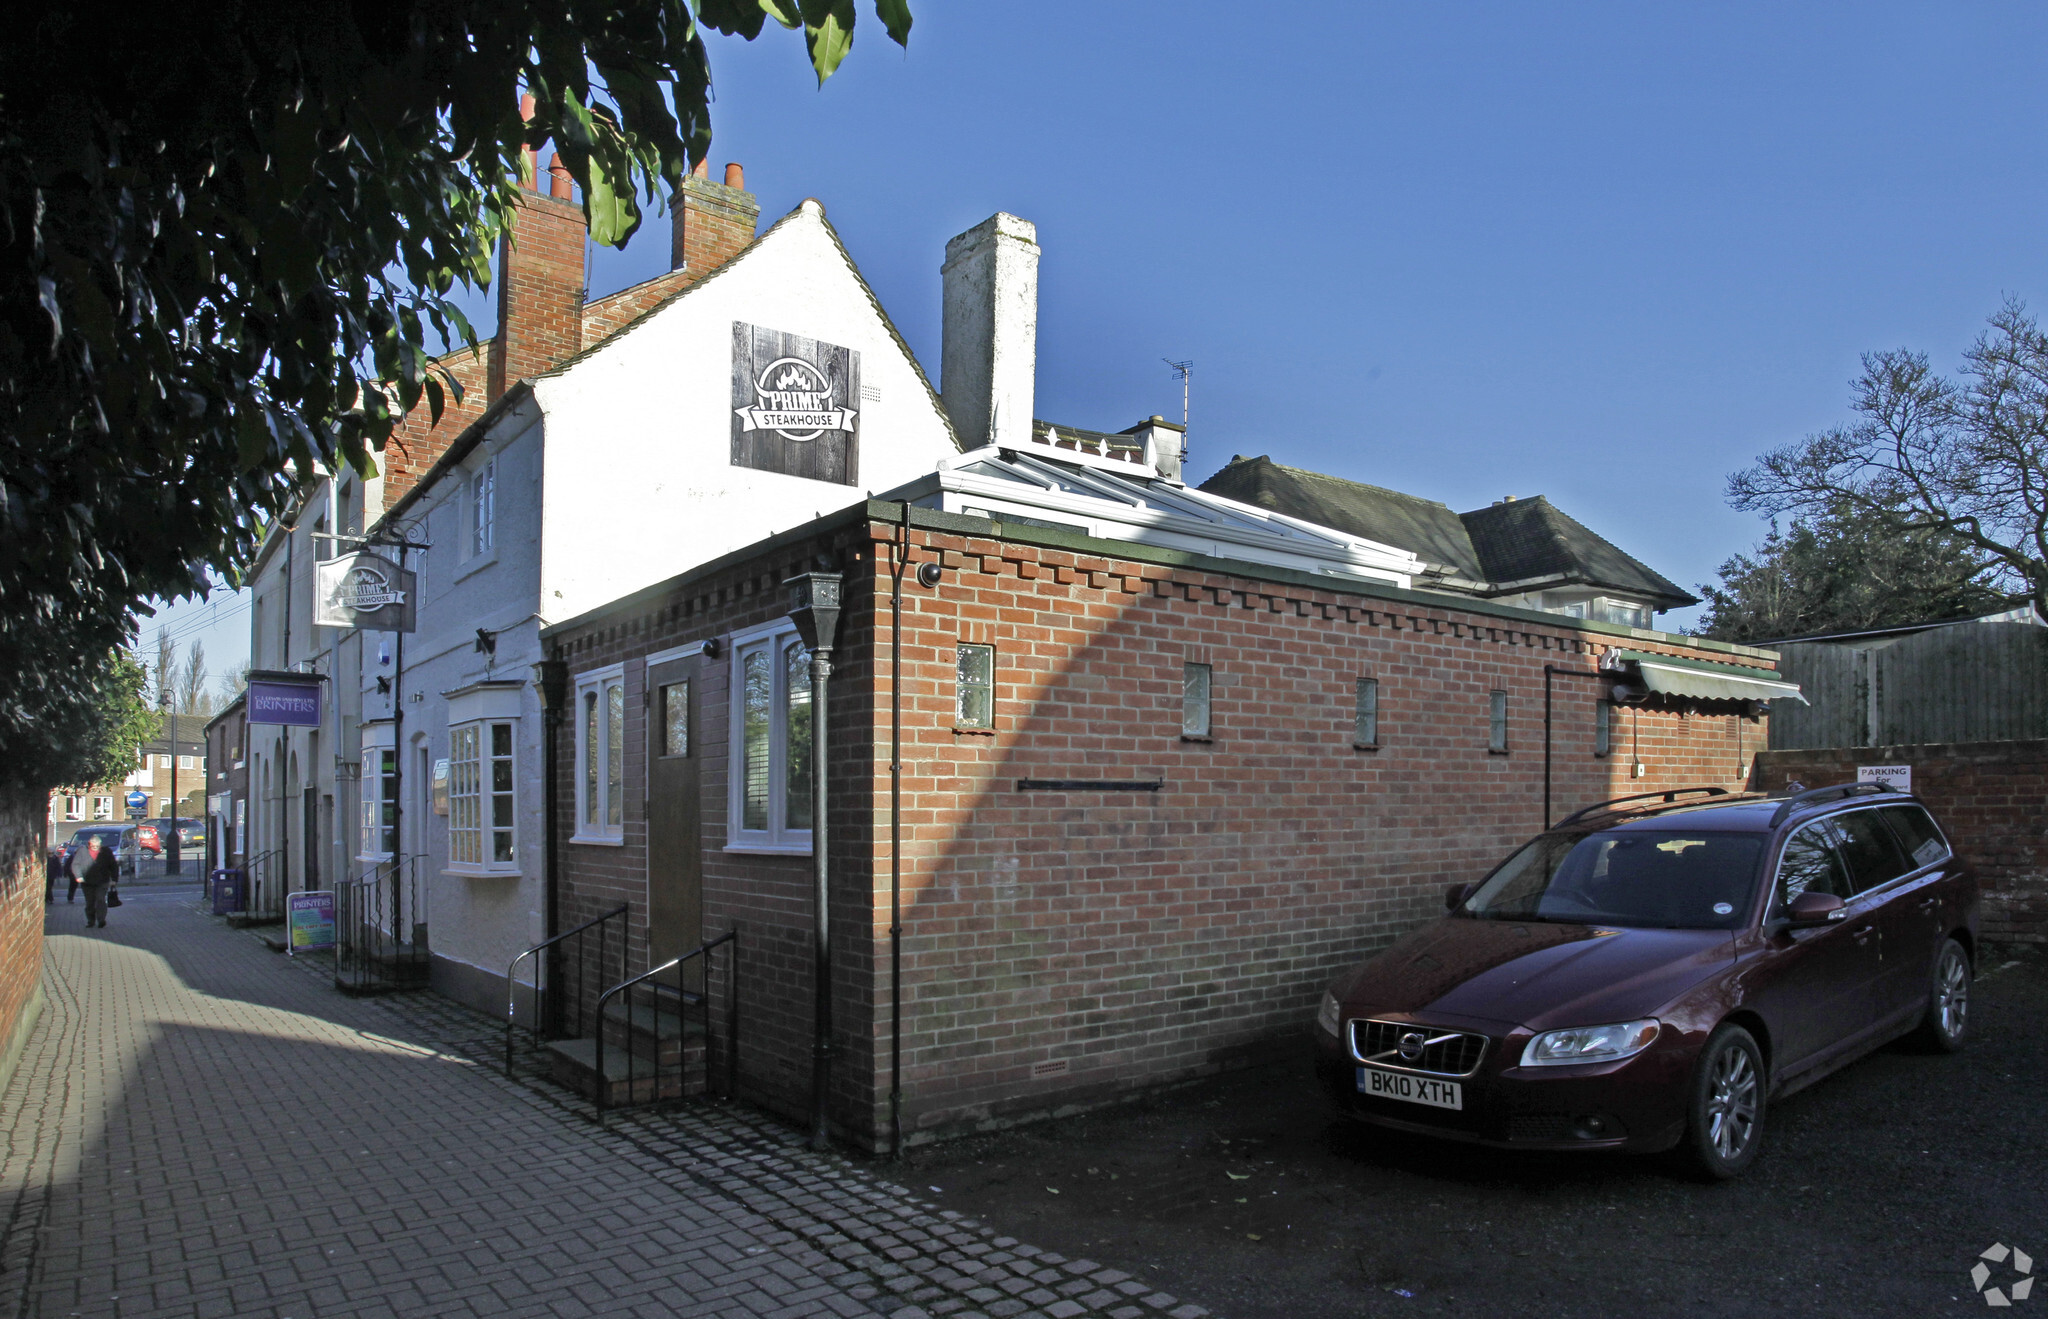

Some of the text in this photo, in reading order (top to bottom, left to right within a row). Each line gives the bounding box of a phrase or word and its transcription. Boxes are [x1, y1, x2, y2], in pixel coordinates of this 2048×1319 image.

[769, 391, 823, 411] PRIME
[763, 414, 833, 426] STEAKHOUSE
[348, 584, 383, 596] PRIME
[343, 595, 390, 605] STEAKHOUSE
[255, 700, 315, 712] PRINTERS
[1861, 768, 1907, 776] PARKING
[294, 899, 331, 909] PRINTERS
[1371, 1072, 1455, 1104] BK10 XTH
